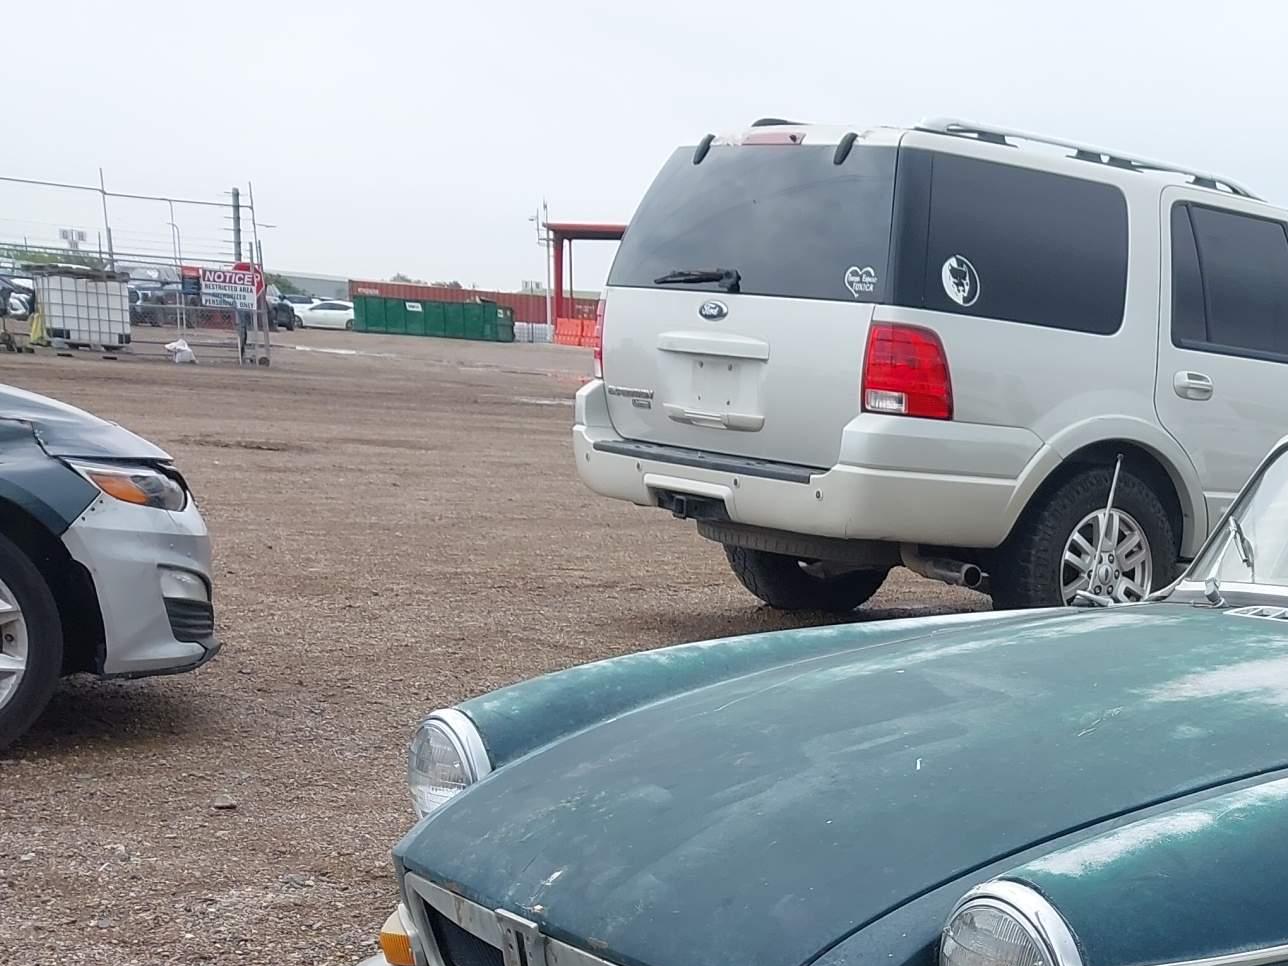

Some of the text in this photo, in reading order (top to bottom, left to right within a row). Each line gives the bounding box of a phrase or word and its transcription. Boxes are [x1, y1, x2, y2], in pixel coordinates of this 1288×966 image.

[204, 271, 253, 285] NOTICE
[204, 283, 254, 294] RESTRICTED AREA
[240, 301, 254, 309] ONLY
